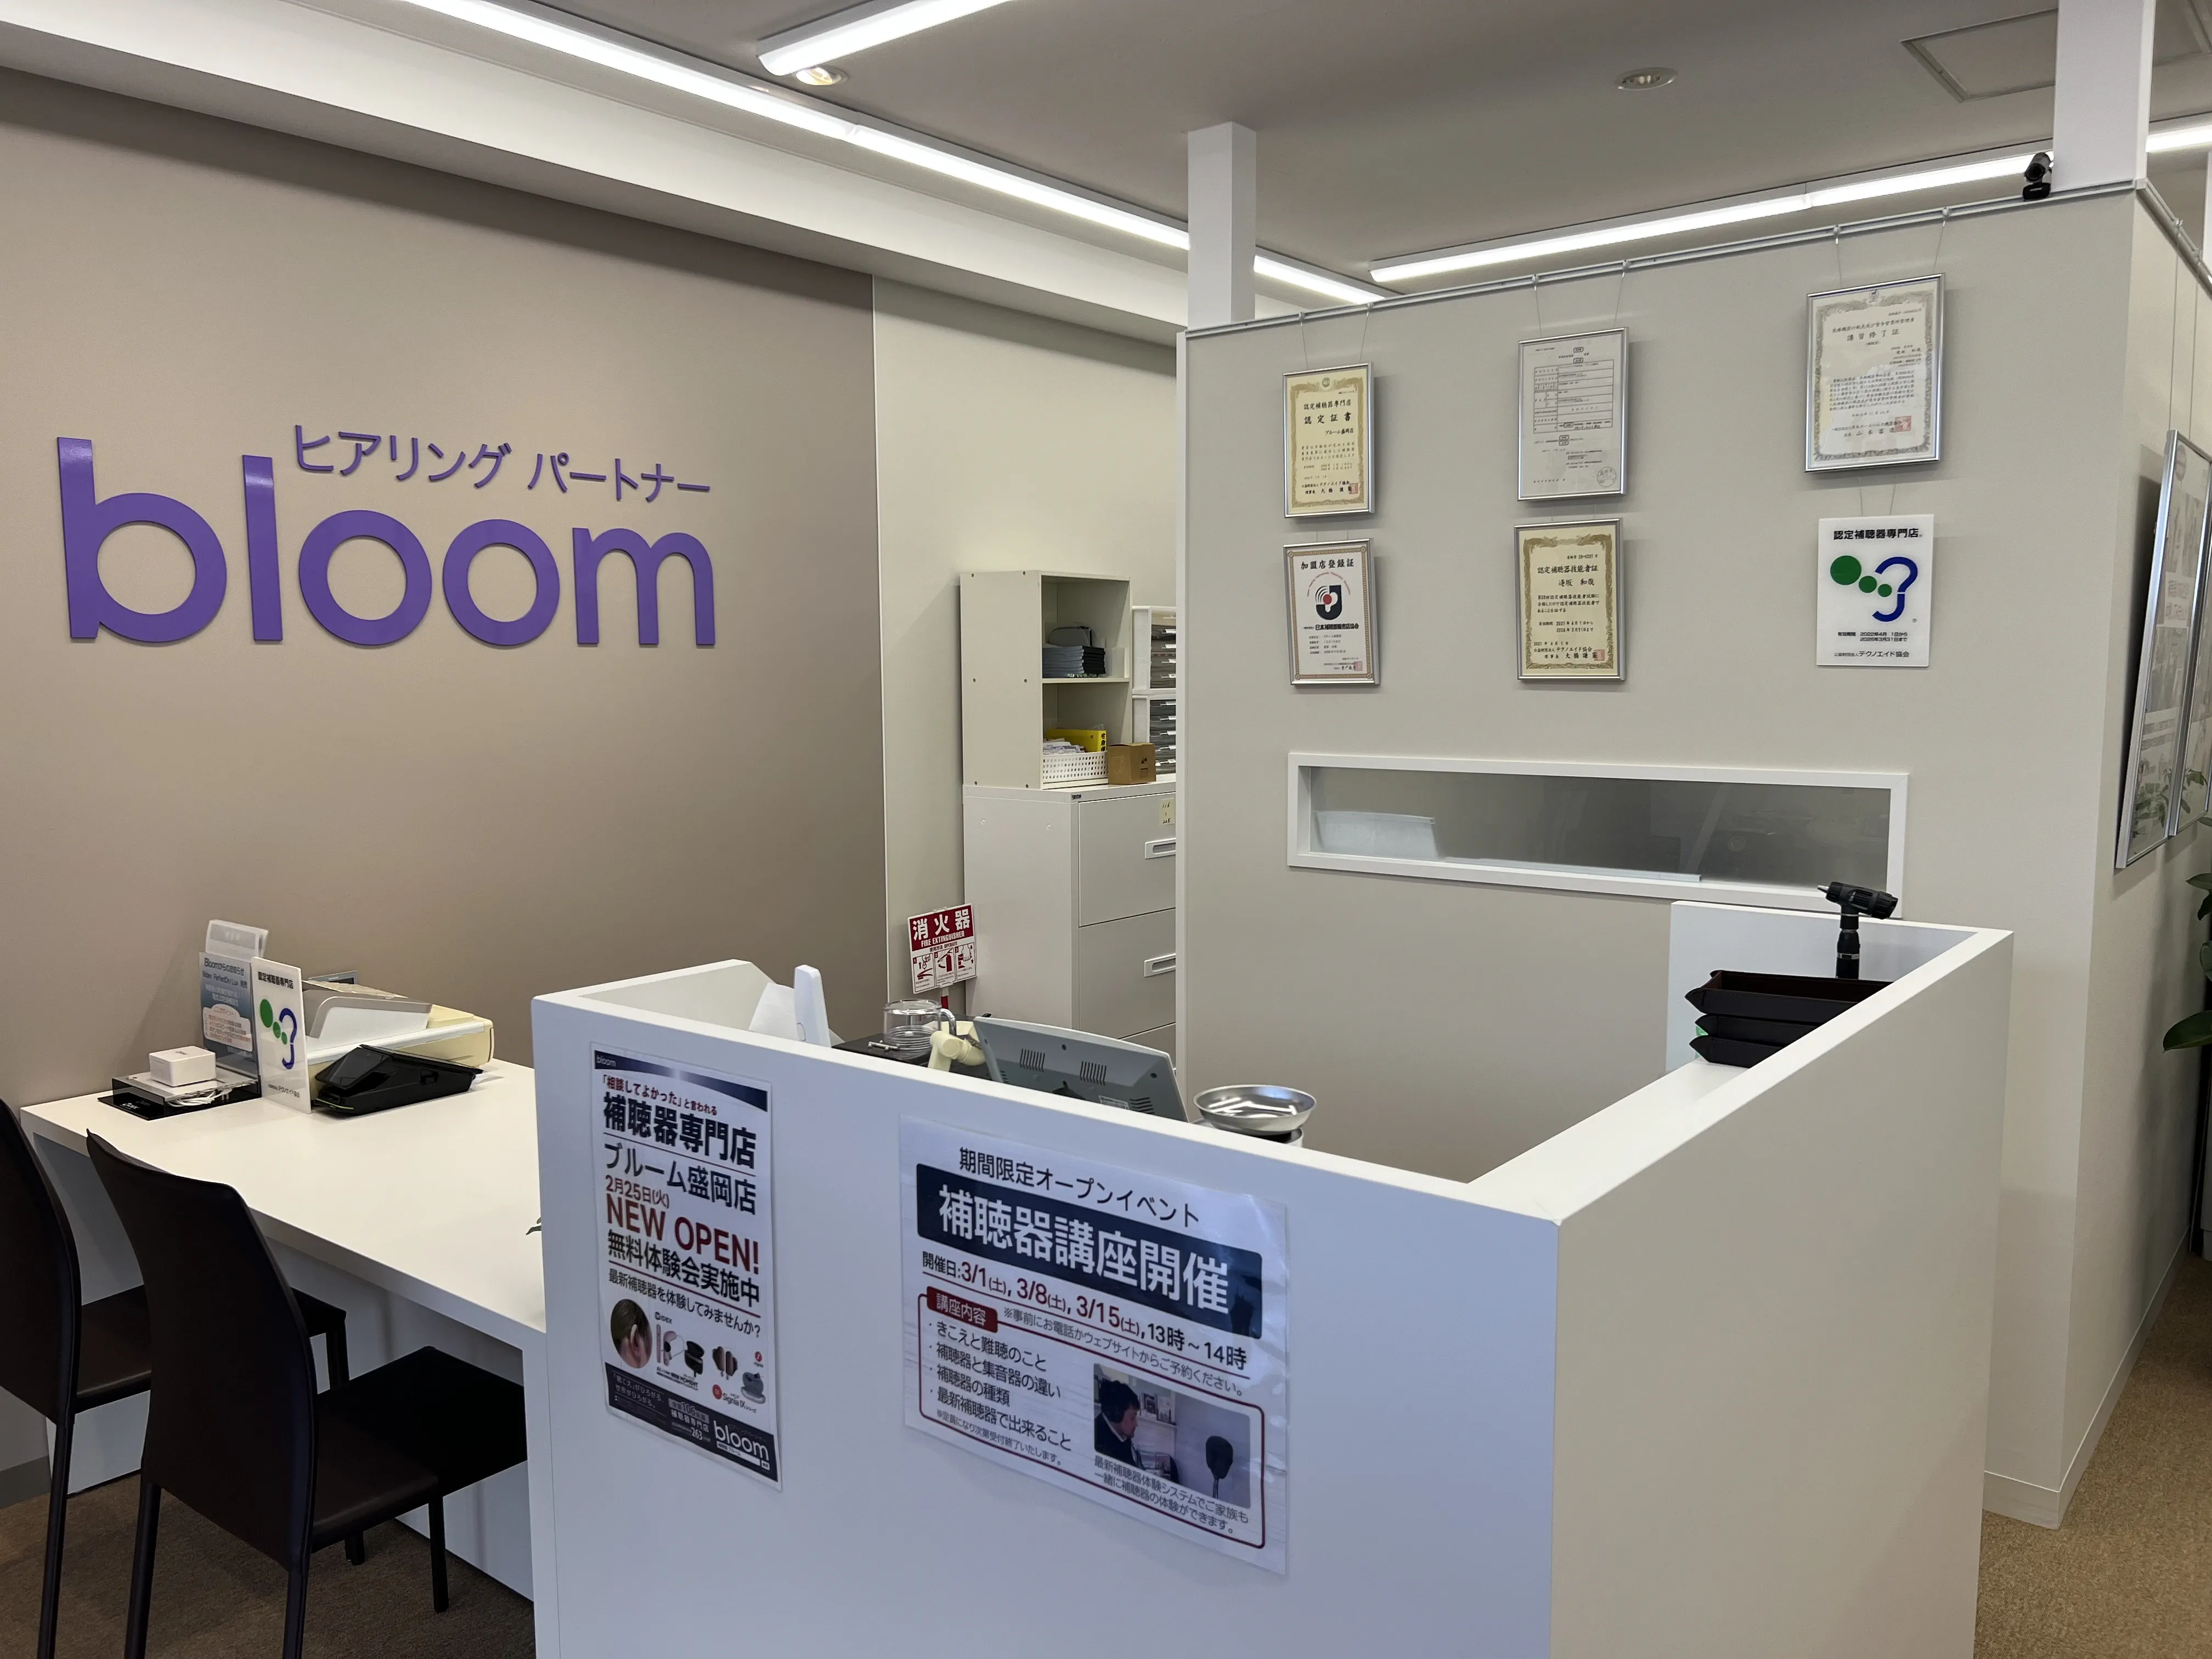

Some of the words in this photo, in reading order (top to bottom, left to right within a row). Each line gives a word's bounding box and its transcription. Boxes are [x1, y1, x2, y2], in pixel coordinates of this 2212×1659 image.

[1304, 399, 1351, 410] 認定補聴器専門店
[1304, 411, 1352, 425] 認定証書
[295, 425, 512, 489] ヒアリング
[528, 452, 712, 503] パートナー
[57, 437, 716, 648] bloom
[1833, 528, 1918, 540] 認定補聴器専門店
[1301, 558, 1355, 571] 加盟店登録証
[1537, 565, 1598, 573] 認定補聴器技能者証
[912, 909, 970, 941] 消火器
[921, 939, 932, 947] FIRE
[933, 930, 964, 945] EXTINGUISHER
[258, 971, 294, 989] 認定補聴器専門店
[596, 1054, 616, 1067] bloom
[602, 1074, 718, 1116] 「相談してよかった」と言われる
[603, 1092, 757, 1169] 補聴器専門店
[605, 1142, 756, 1215] ブルーム盛岡店
[605, 1175, 670, 1209] 2月25日(火)
[960, 1146, 1199, 1228] 期間限定オープンイベント
[606, 1193, 666, 1241] NEW
[675, 1216, 759, 1274] OPEN!
[939, 1184, 1229, 1315] 補聴器講座開催
[607, 1229, 760, 1307] 無料体験会実施中
[609, 1268, 761, 1338] 最新補聴器を体験してみませんか?
[936, 1292, 987, 1327] 講座内容
[936, 1342, 1060, 1398] 補聴器と集音器の違い
[937, 1321, 1047, 1372] きこえと難聴のこと
[936, 1364, 1010, 1407] 補聴器の種類
[713, 1420, 769, 1461] bloom
[937, 1386, 1071, 1452] 最新補聴器で出来ること
[1094, 1455, 1249, 1524] 最新補聴器体験システムでご家族も
[1094, 1472, 1233, 1534] 一緒に補聴器の体験ができます。
